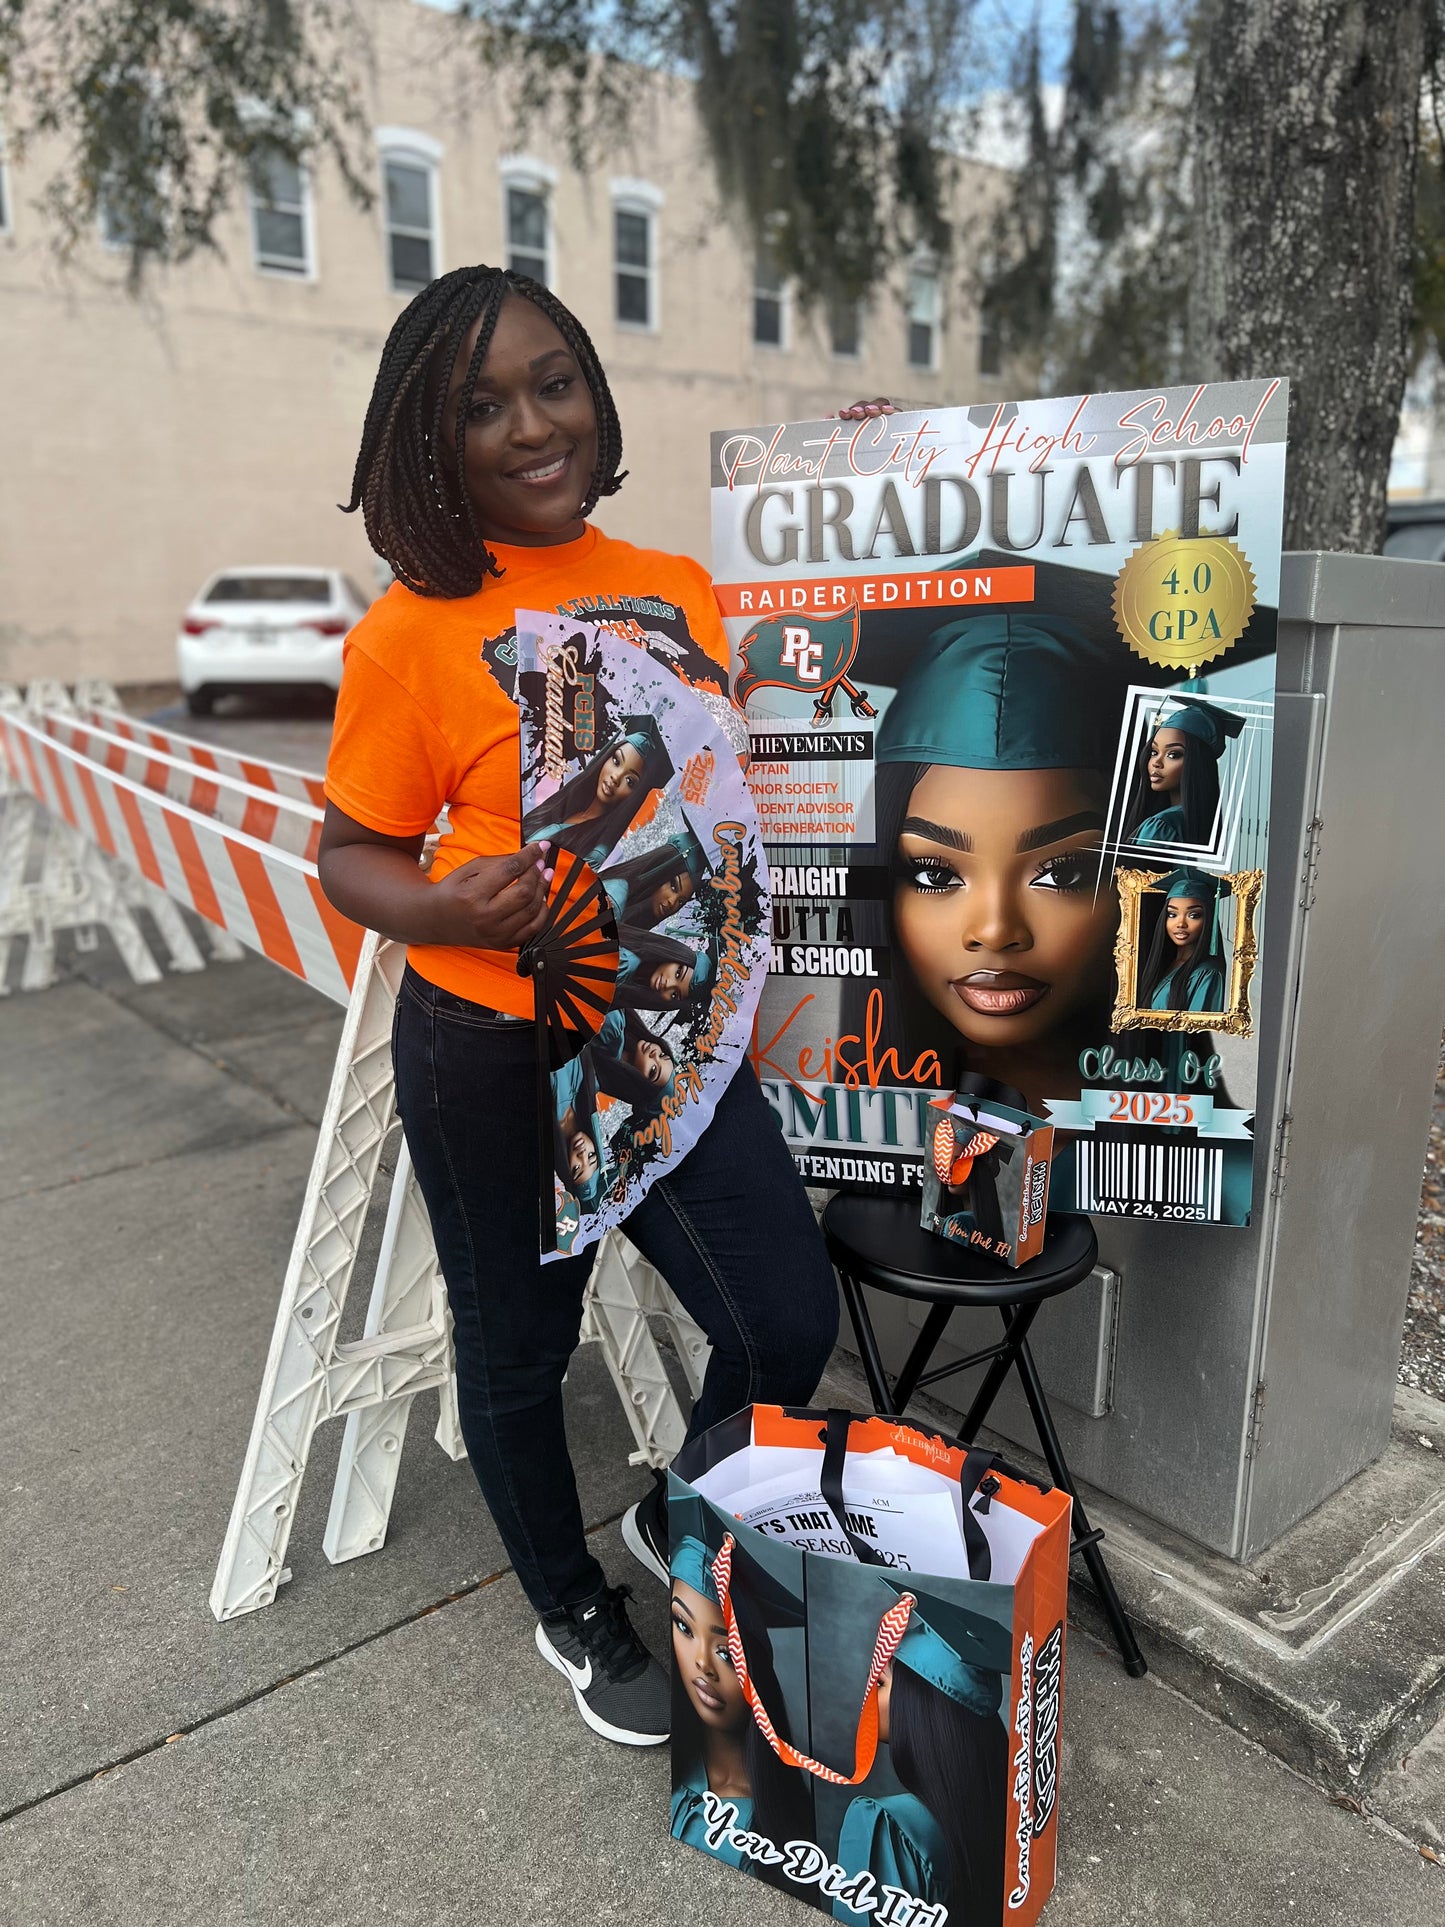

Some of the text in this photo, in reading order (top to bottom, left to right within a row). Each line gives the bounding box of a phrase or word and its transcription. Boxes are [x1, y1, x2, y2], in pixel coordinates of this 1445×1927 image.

[720, 378, 1281, 496] Plant City High School
[746, 456, 1241, 567] GRADUATE
[740, 576, 992, 610] RAIDER EDITION
[1161, 563, 1212, 595] 4.0
[1149, 608, 1223, 641] GPA
[780, 625, 824, 682] PC
[572, 672, 596, 751] PCHS
[750, 734, 866, 754] HIEVEMENTS
[684, 753, 708, 805] 2025
[748, 783, 839, 795] ONOR SOCIETY
[796, 802, 854, 814] ADVISOR
[773, 822, 856, 834] GENERATION
[769, 866, 849, 896] RAIGHT
[697, 820, 753, 1061] Congratulations
[772, 905, 855, 942] UTTA
[790, 945, 879, 977] SCHOOL
[748, 987, 942, 1105] Keisha
[1078, 1045, 1223, 1088] Class Of
[634, 1062, 705, 1158] Keisha
[1109, 1091, 1195, 1125] 2025
[791, 1154, 896, 1184] TENDING
[1091, 1199, 1206, 1221] MAY 24, 2025
[948, 1219, 1013, 1259] You Did It!
[753, 1511, 878, 1539] T'S THAT IME
[1008, 1631, 1034, 1909] Congratulations
[702, 1791, 785, 1864] You
[783, 1840, 878, 1914] Did
